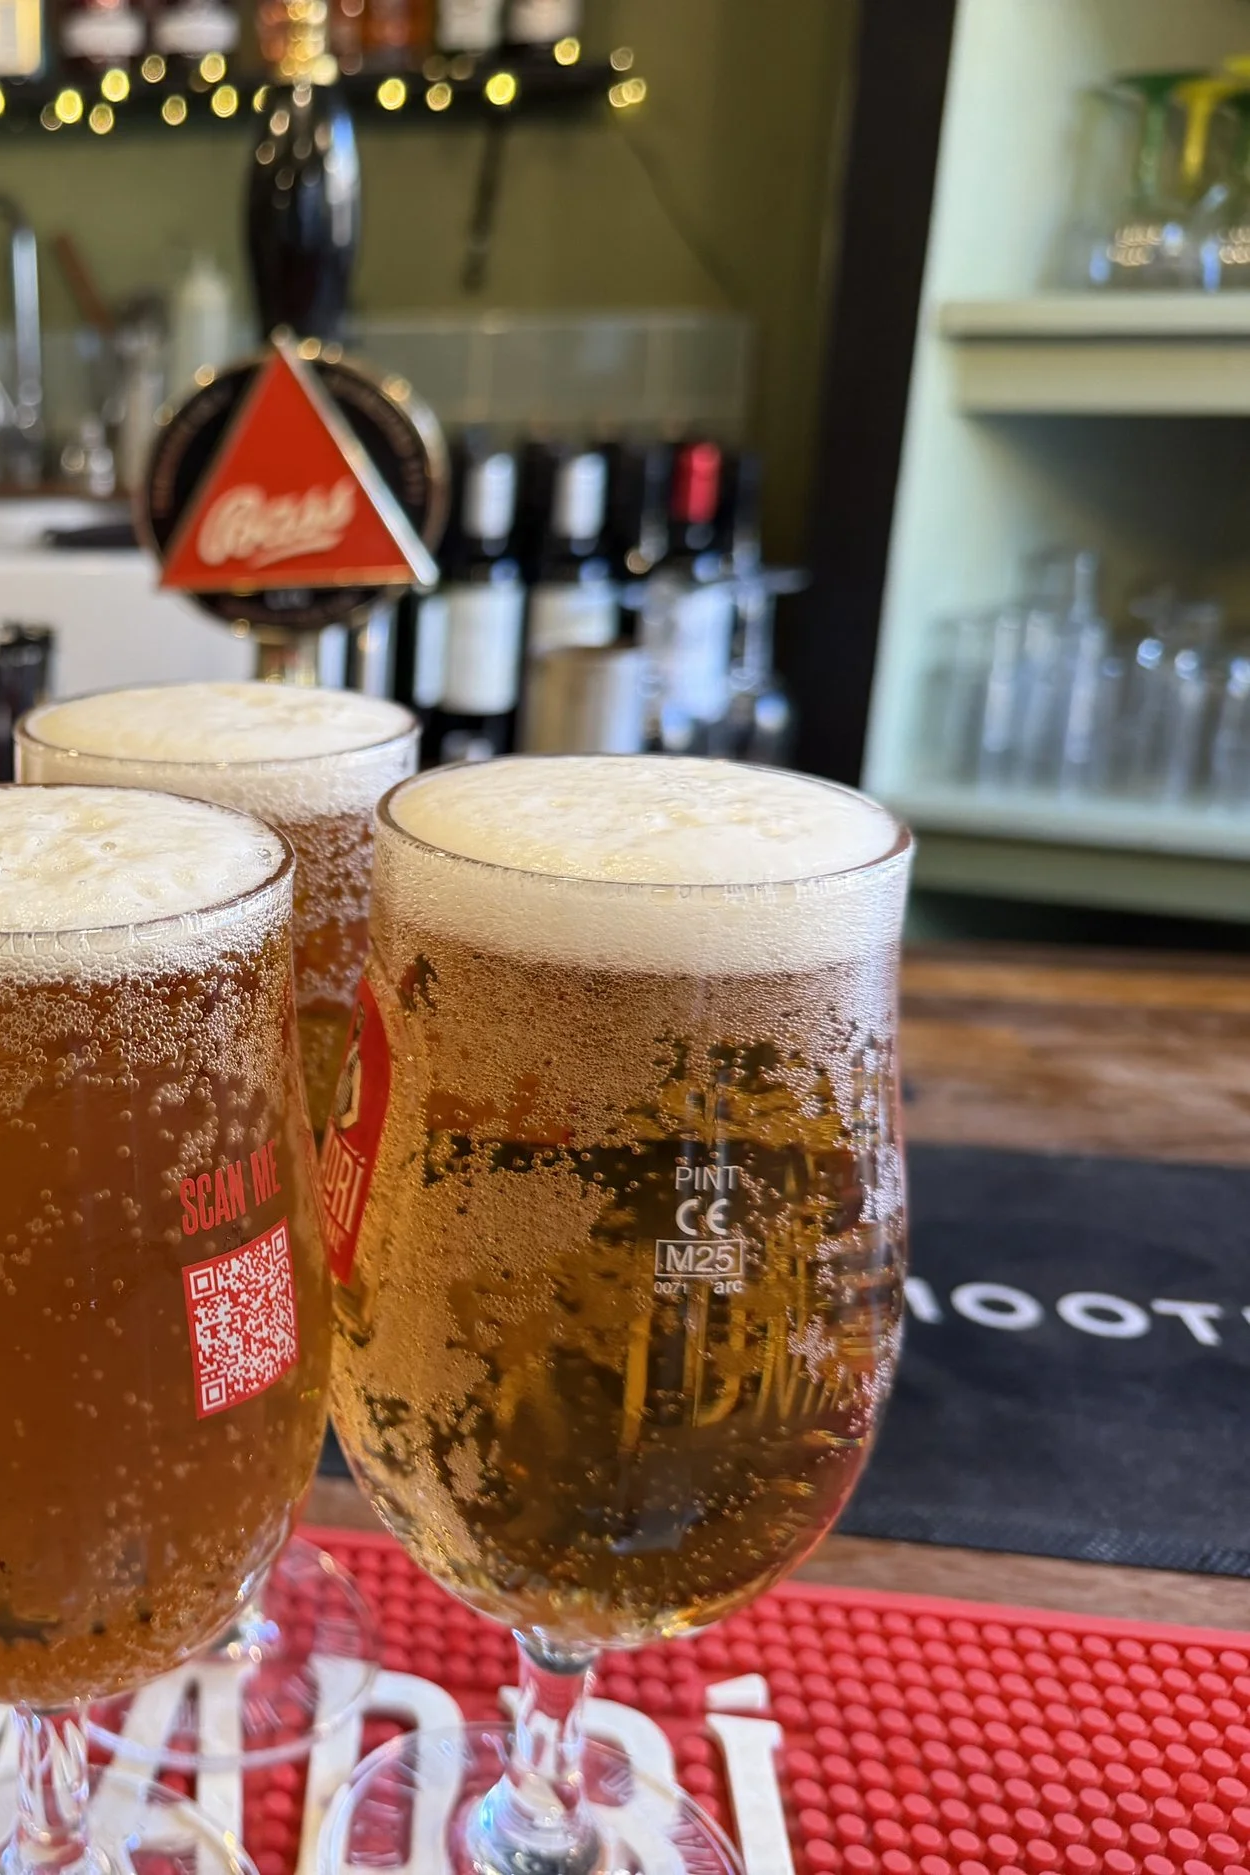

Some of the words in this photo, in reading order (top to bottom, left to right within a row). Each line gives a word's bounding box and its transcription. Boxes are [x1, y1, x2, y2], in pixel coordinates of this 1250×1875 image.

[180, 1160, 246, 1235] SCAN
[251, 1138, 282, 1206] ME
[675, 1166, 740, 1191] PINT
[666, 1244, 735, 1273] M25
